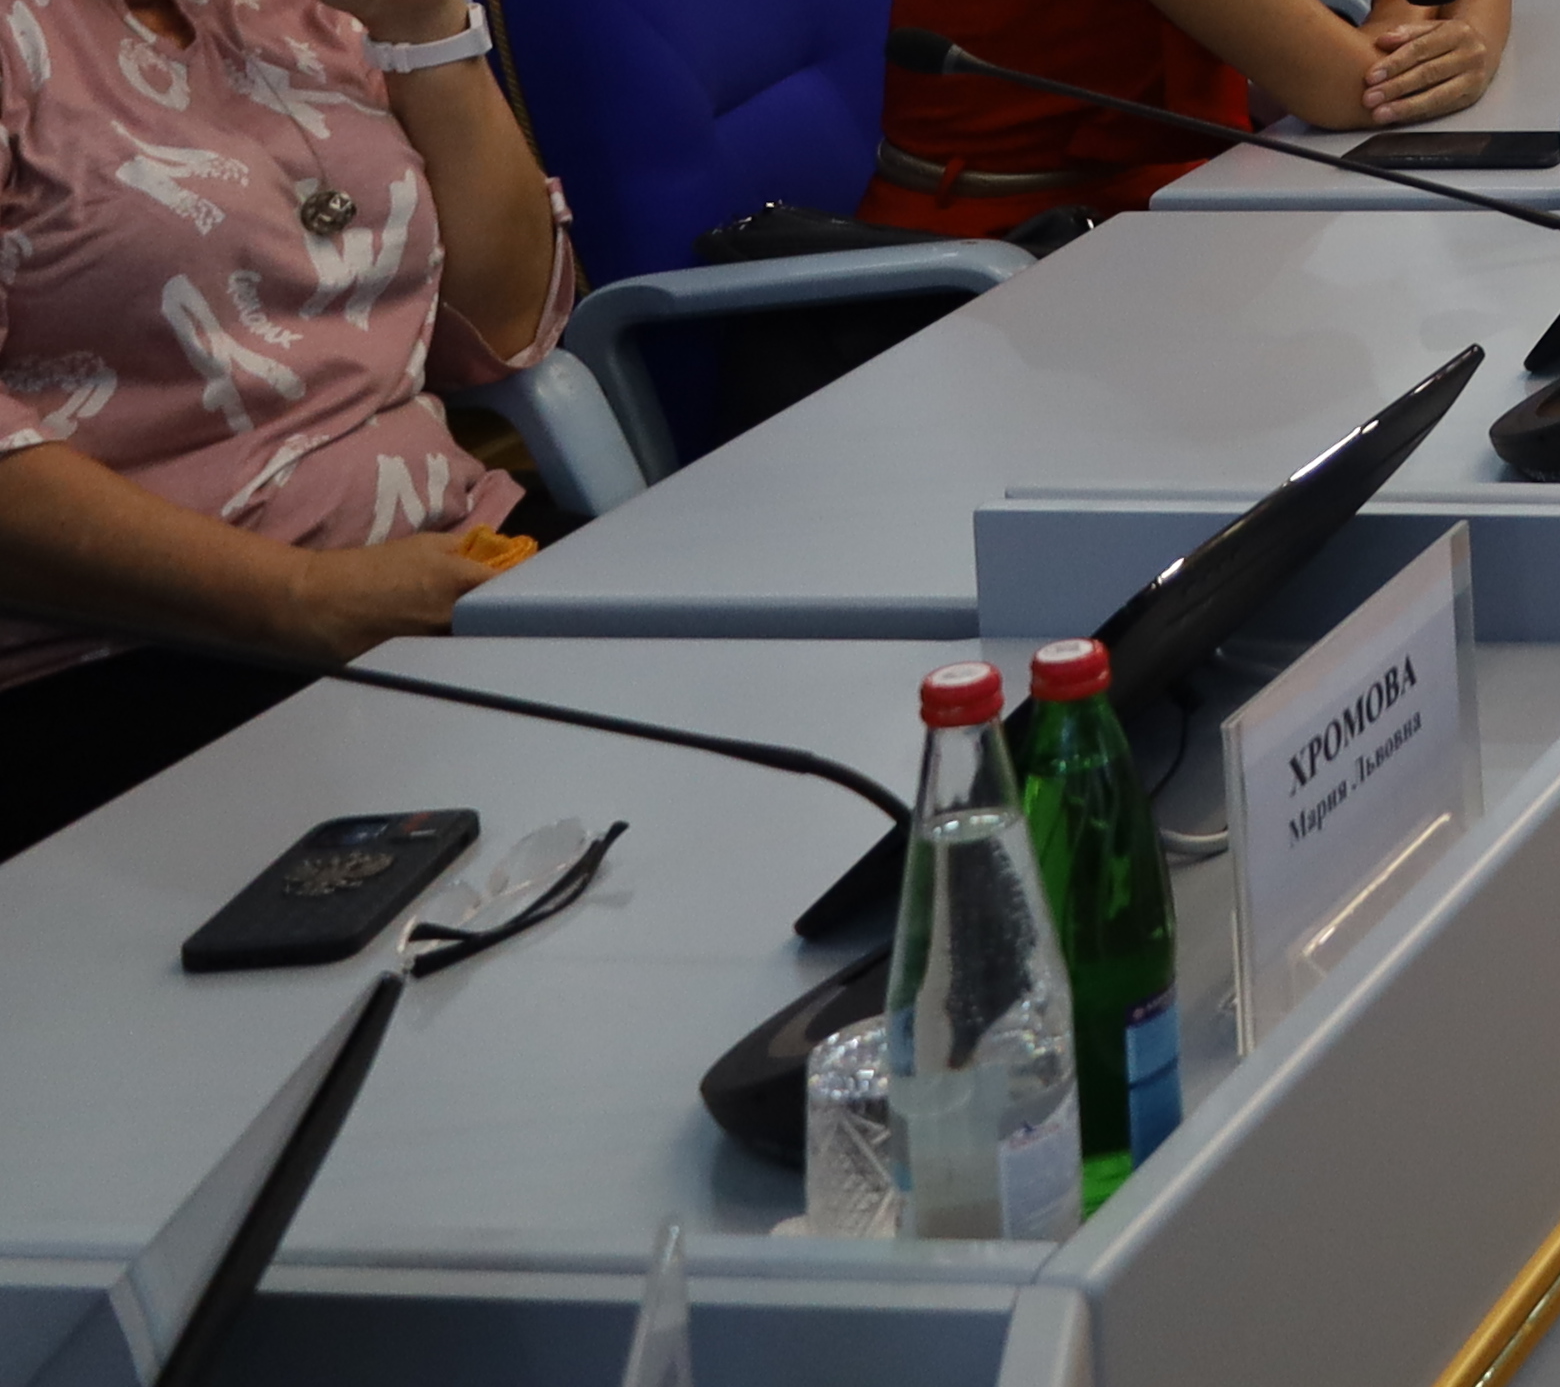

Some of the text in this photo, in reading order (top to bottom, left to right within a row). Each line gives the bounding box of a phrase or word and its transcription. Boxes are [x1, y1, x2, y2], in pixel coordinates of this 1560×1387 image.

[1287, 652, 1419, 798] ХРОМОВА
[1287, 710, 1424, 849] Мария Львовна
